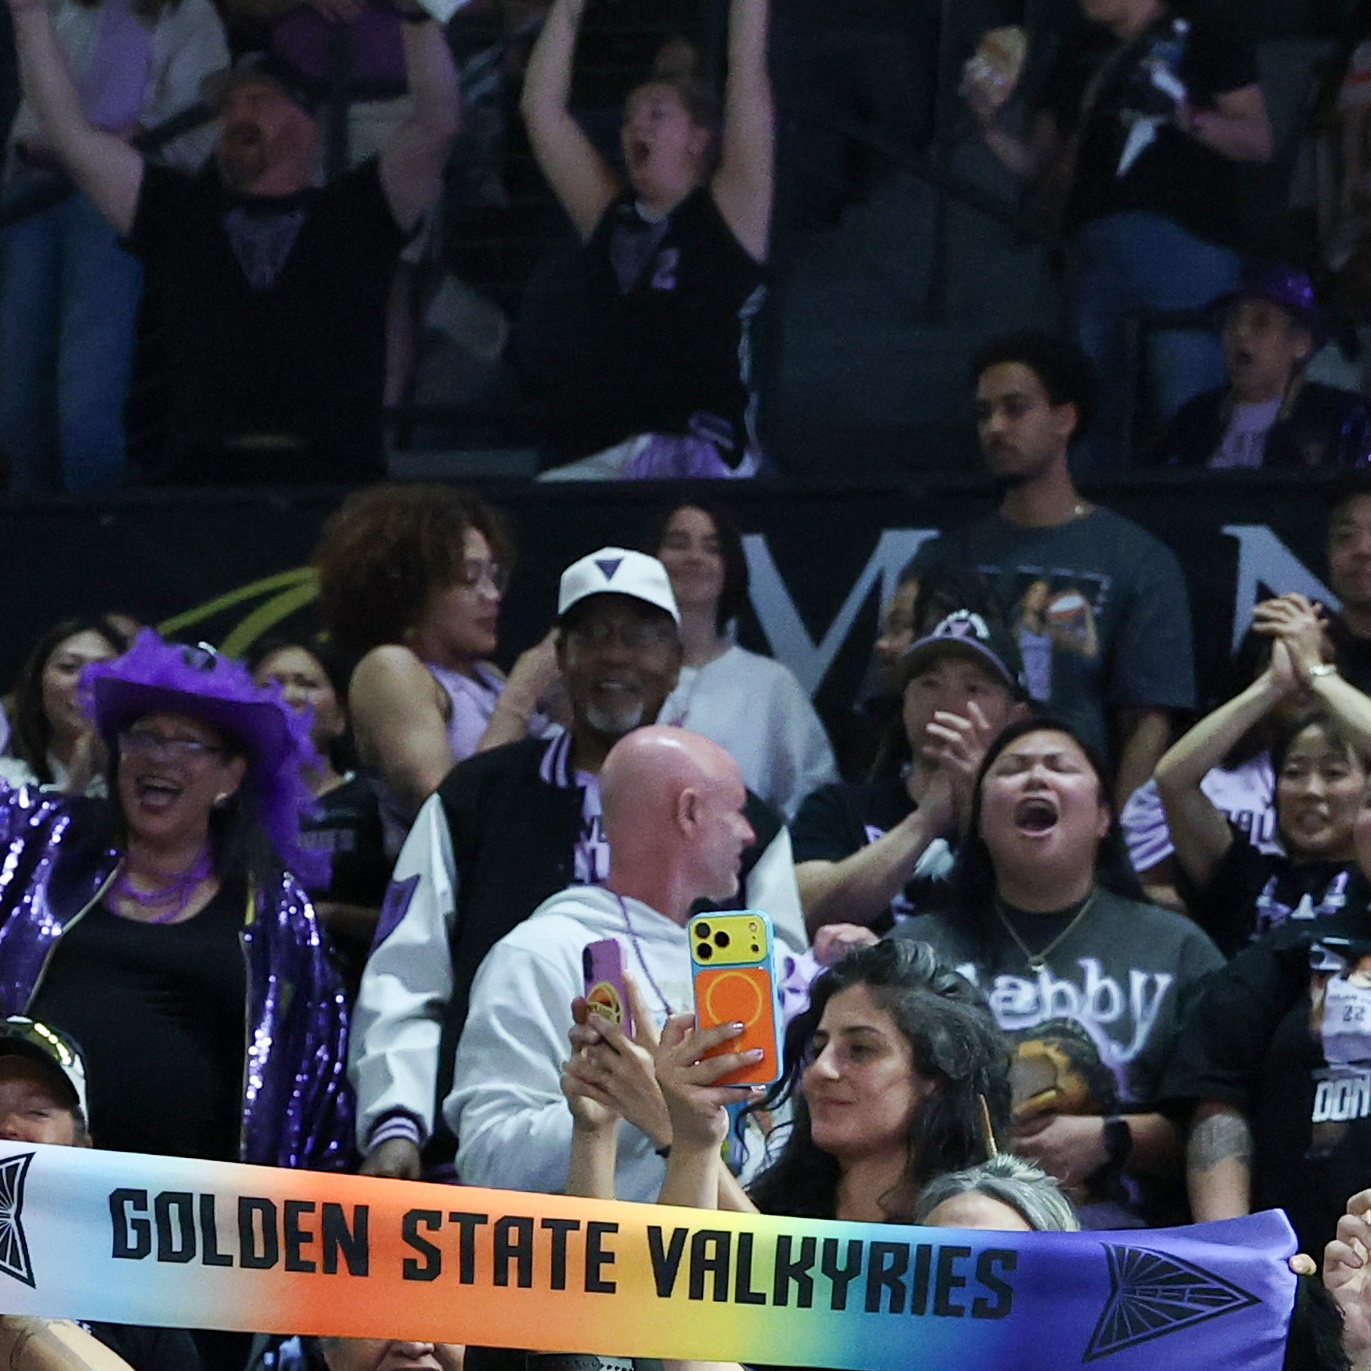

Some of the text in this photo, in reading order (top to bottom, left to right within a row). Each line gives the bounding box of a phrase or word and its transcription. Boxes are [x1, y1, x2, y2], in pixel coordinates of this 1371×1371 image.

[955, 957, 1174, 1064] abby
[109, 1187, 1018, 1320] GOLDEN STATE VALKYRIES
